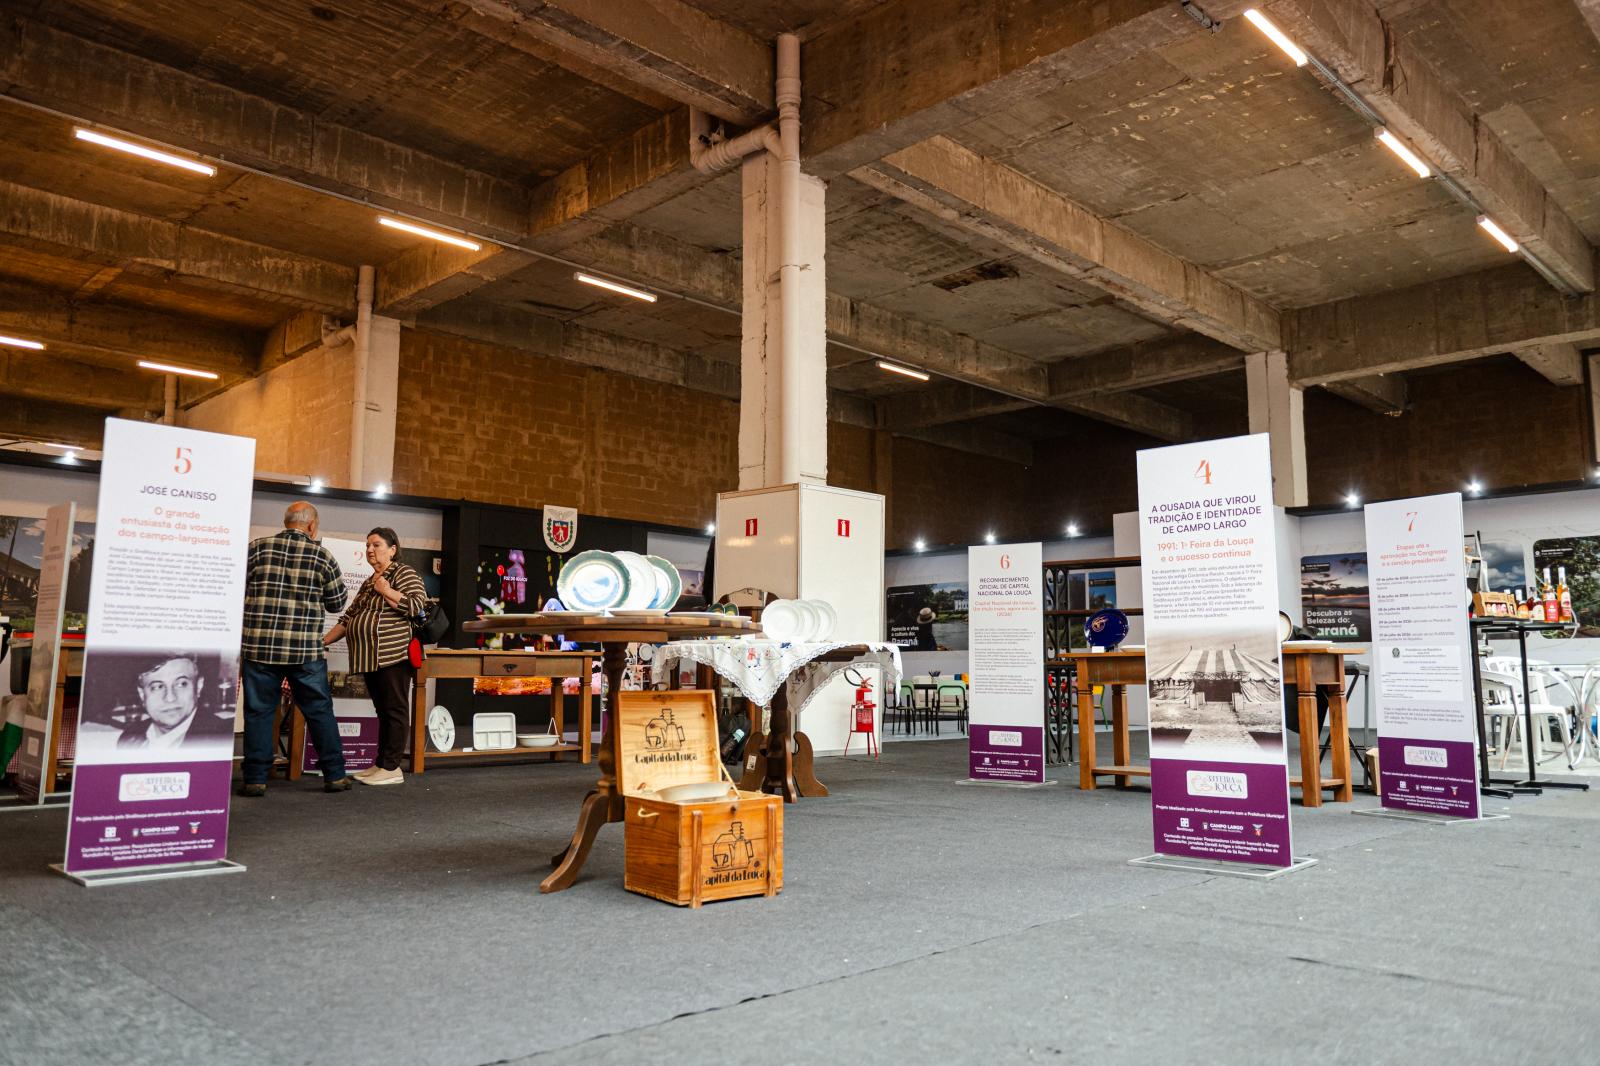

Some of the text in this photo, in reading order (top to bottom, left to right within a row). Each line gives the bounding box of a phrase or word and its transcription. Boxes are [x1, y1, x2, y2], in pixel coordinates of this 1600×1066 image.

[174, 447, 192, 474] 5
[1194, 459, 1212, 484] 4
[140, 484, 217, 501] JOSÉ CANISSO
[1152, 494, 1256, 513] A OUSADIA QUE VIROU
[154, 506, 201, 519] O grande
[1148, 506, 1262, 526] TRADIÇÃO E IDENTIDADE
[121, 517, 230, 535] entusiasta da vocação
[1162, 519, 1247, 535] DE CAMPO LARGO
[1407, 512, 1418, 532] 7
[118, 528, 231, 546] dos campo-larguenses
[1157, 542, 1178, 551] 1991:
[1189, 540, 1211, 549] Feira
[1213, 538, 1225, 547] da
[1227, 536, 1254, 547] Louça
[354, 551, 364, 566] 2
[1000, 554, 1010, 570] 6
[1176, 553, 1210, 562] sucesso
[1212, 549, 1252, 559] continua
[1013, 589, 1032, 597] LOUÇA
[1306, 609, 1342, 617] Descubra
[1306, 616, 1351, 625] Belezas do:
[1317, 623, 1358, 636] araná
[635, 753, 664, 765] Capital
[704, 872, 730, 885] apital
